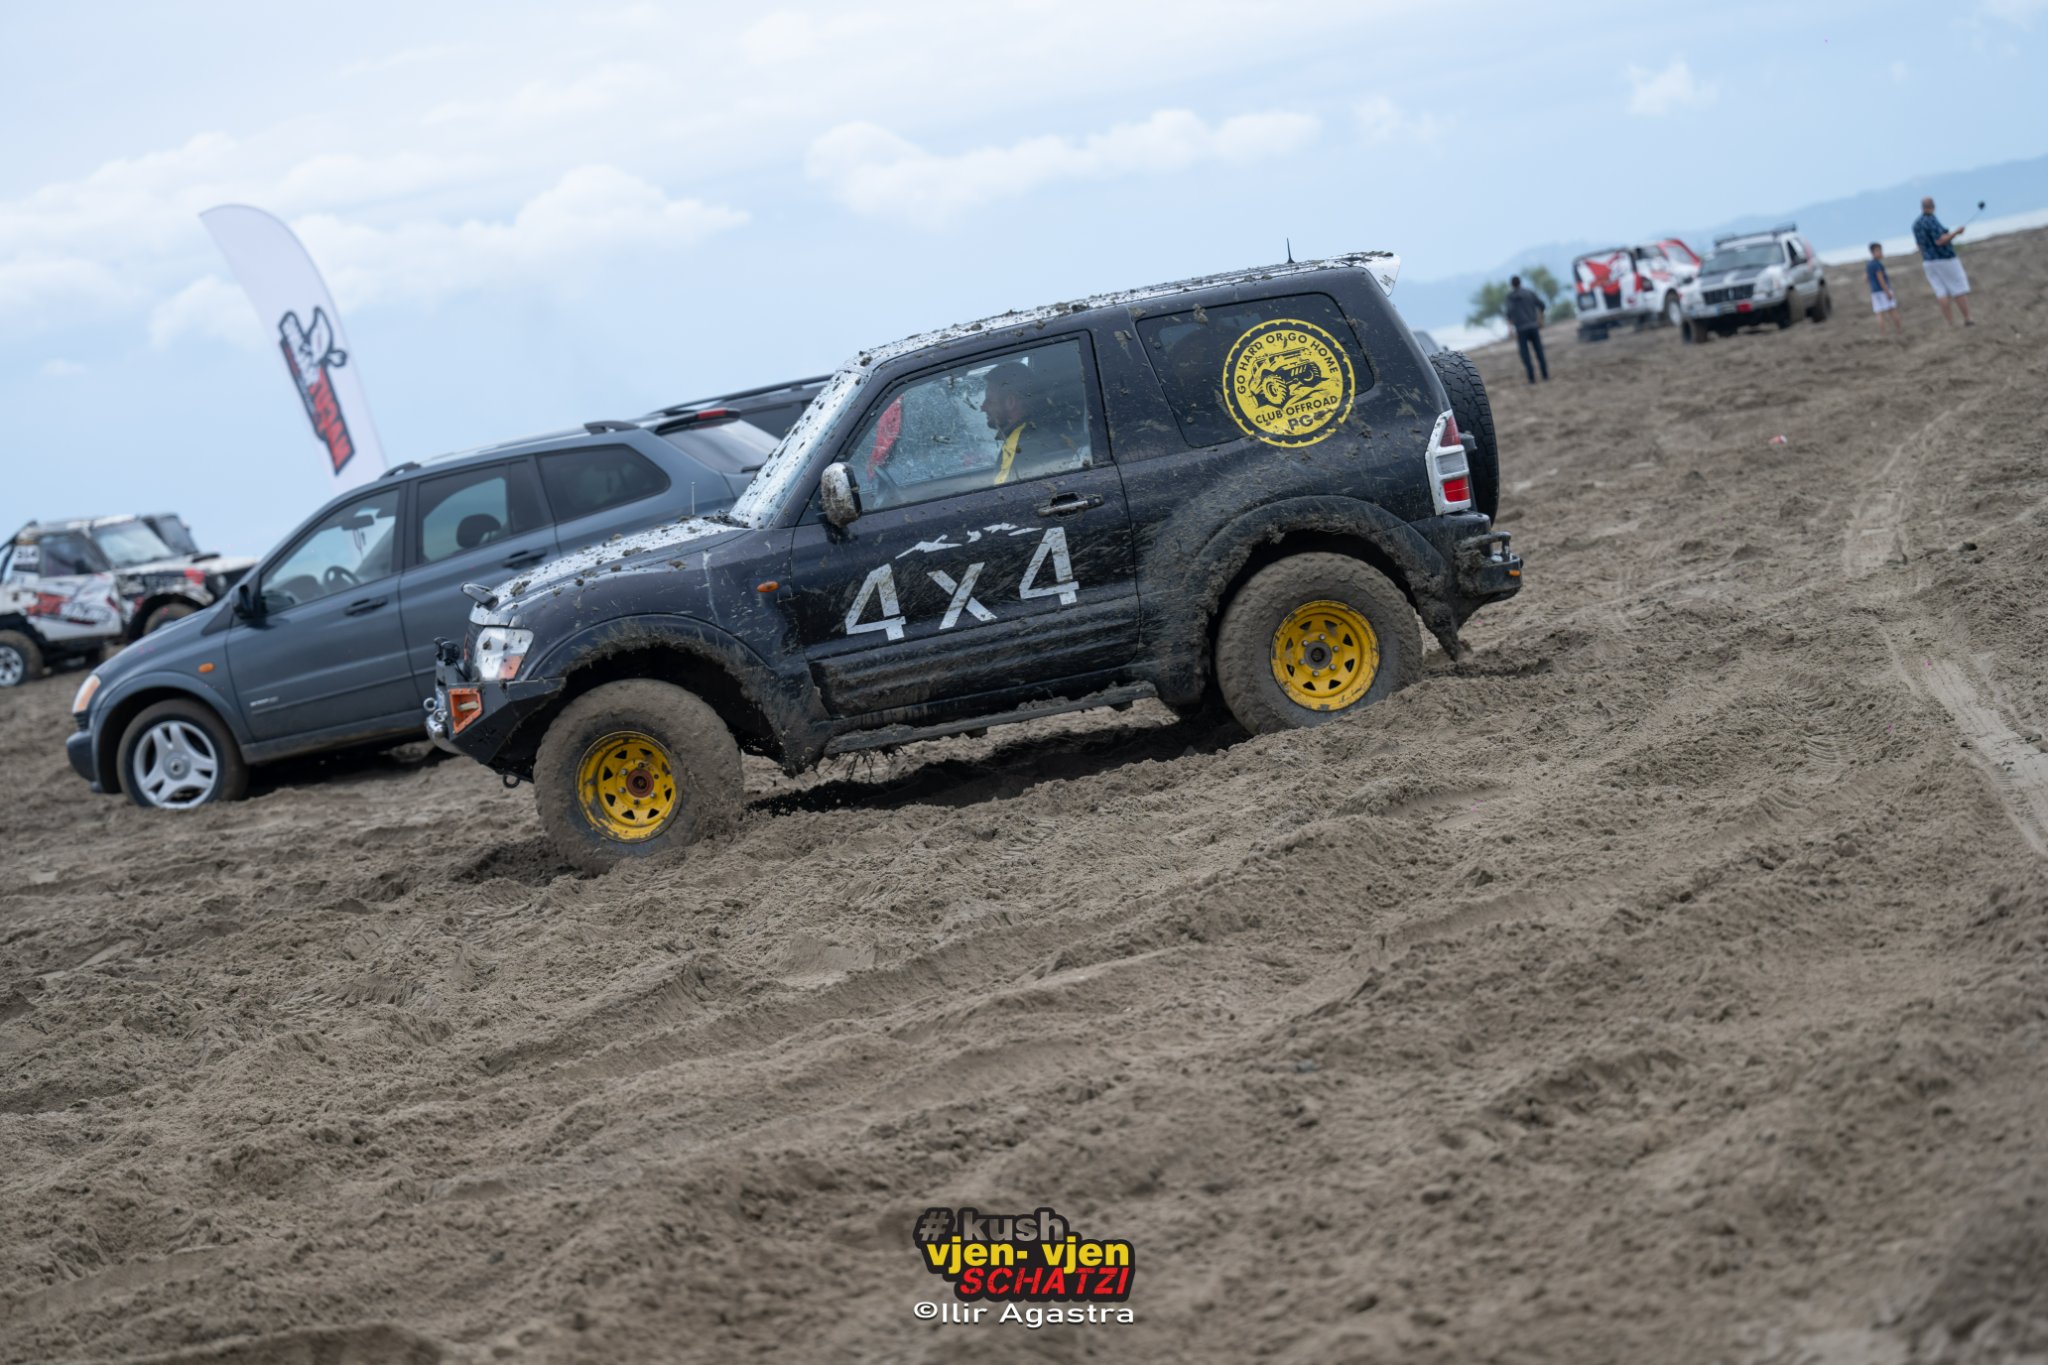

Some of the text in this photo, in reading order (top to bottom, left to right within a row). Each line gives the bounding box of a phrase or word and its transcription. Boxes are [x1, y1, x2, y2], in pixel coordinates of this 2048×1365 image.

[1237, 333, 1339, 394] GO HARD OR GO HOME
[1255, 395, 1338, 424] CLUB OFFROAD
